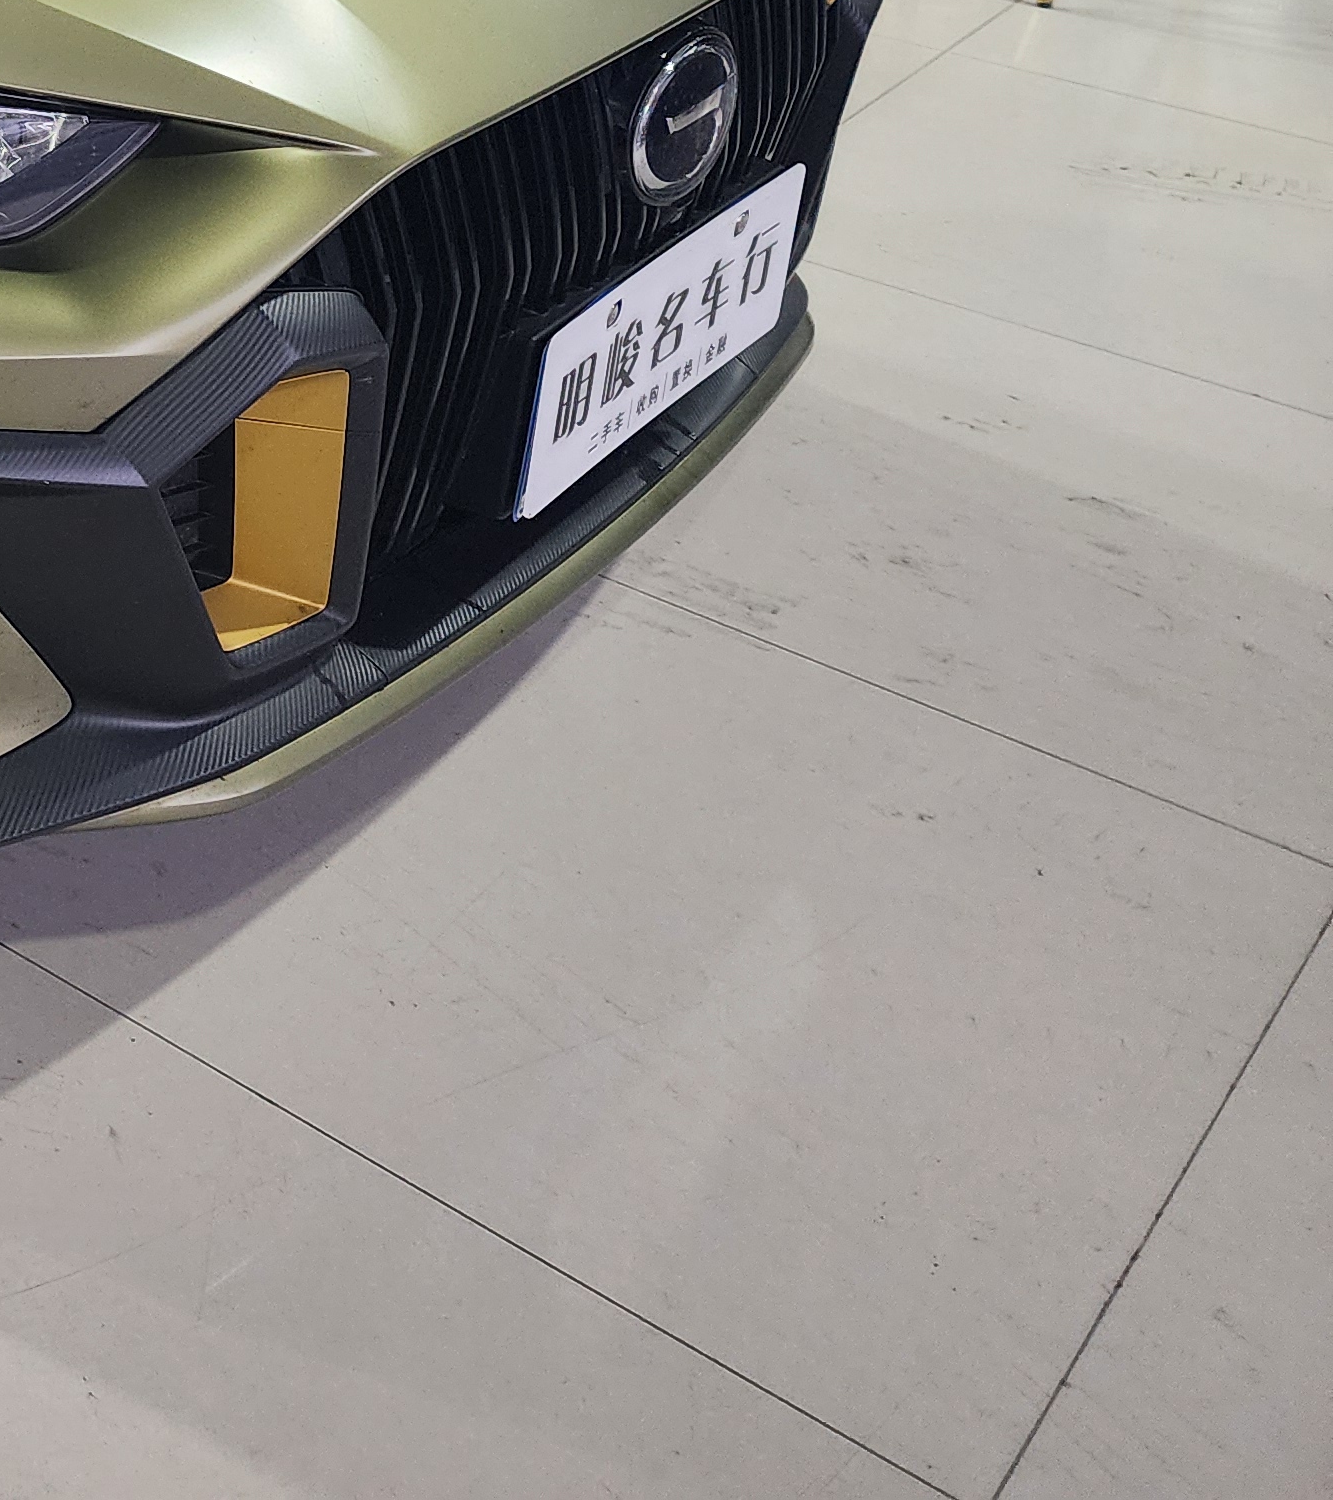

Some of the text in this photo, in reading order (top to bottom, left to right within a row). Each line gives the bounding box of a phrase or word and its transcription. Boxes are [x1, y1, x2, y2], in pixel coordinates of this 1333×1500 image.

[552, 222, 781, 445] 明峻名车行
